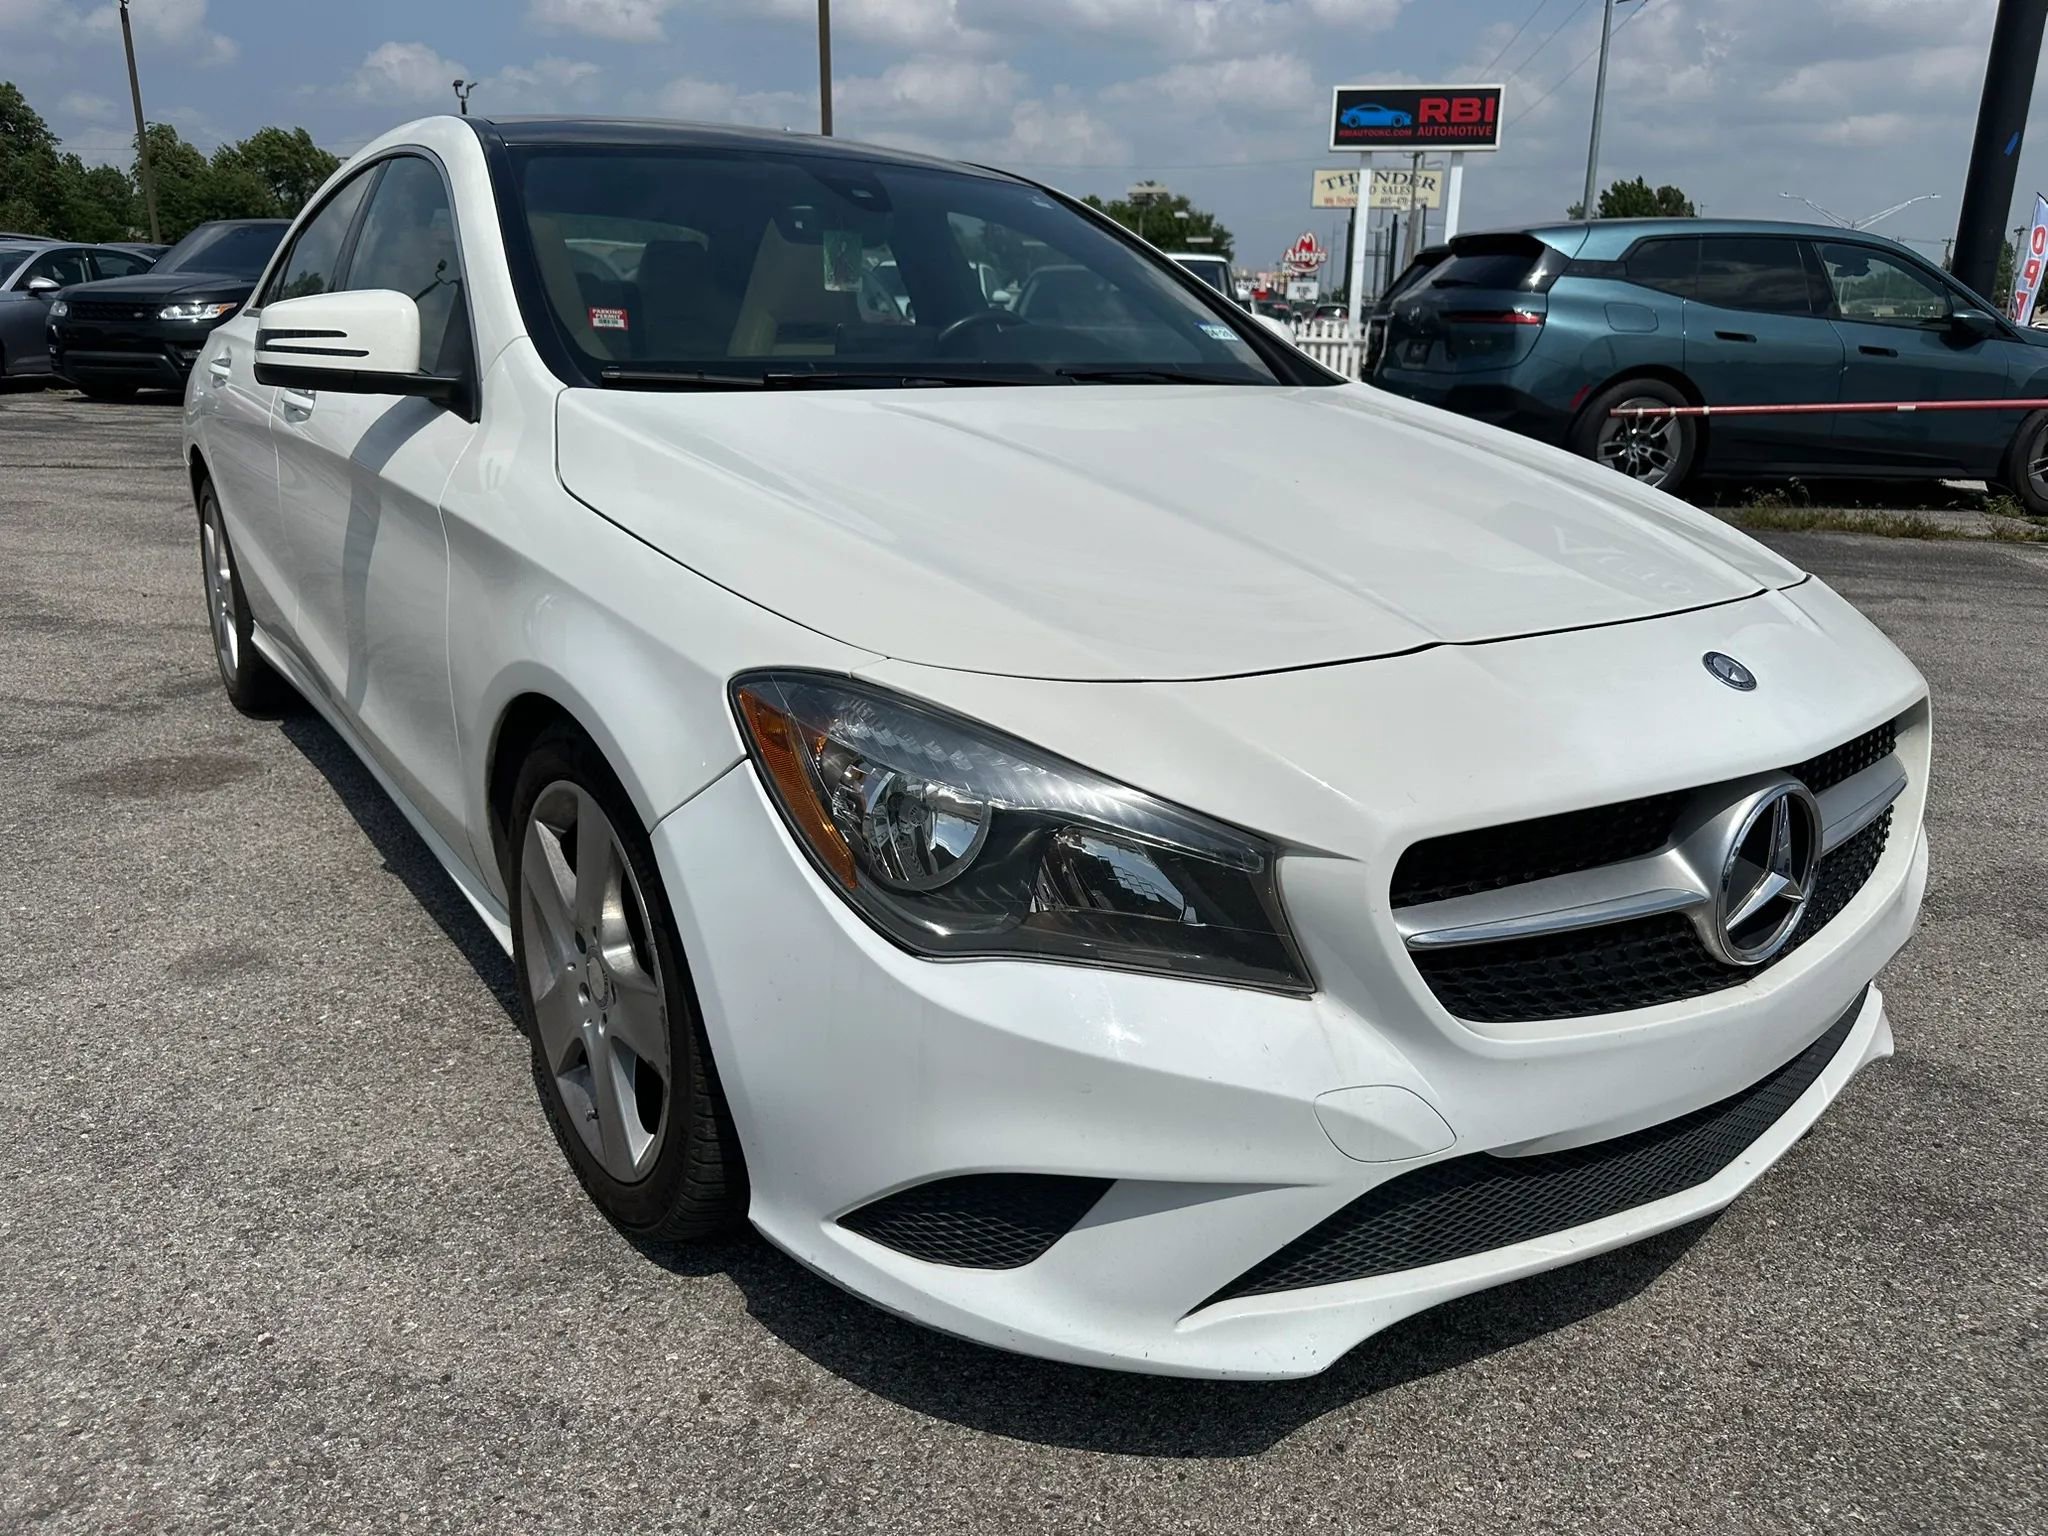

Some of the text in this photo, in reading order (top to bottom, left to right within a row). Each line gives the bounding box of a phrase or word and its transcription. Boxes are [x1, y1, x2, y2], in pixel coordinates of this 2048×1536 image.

[1418, 97, 1496, 123] RBI
[1417, 125, 1493, 137] AUTOMOTIVE
[1320, 171, 1436, 192] THNDER
[1382, 185, 1411, 195] SALES
[1285, 249, 1326, 264] Arby's
